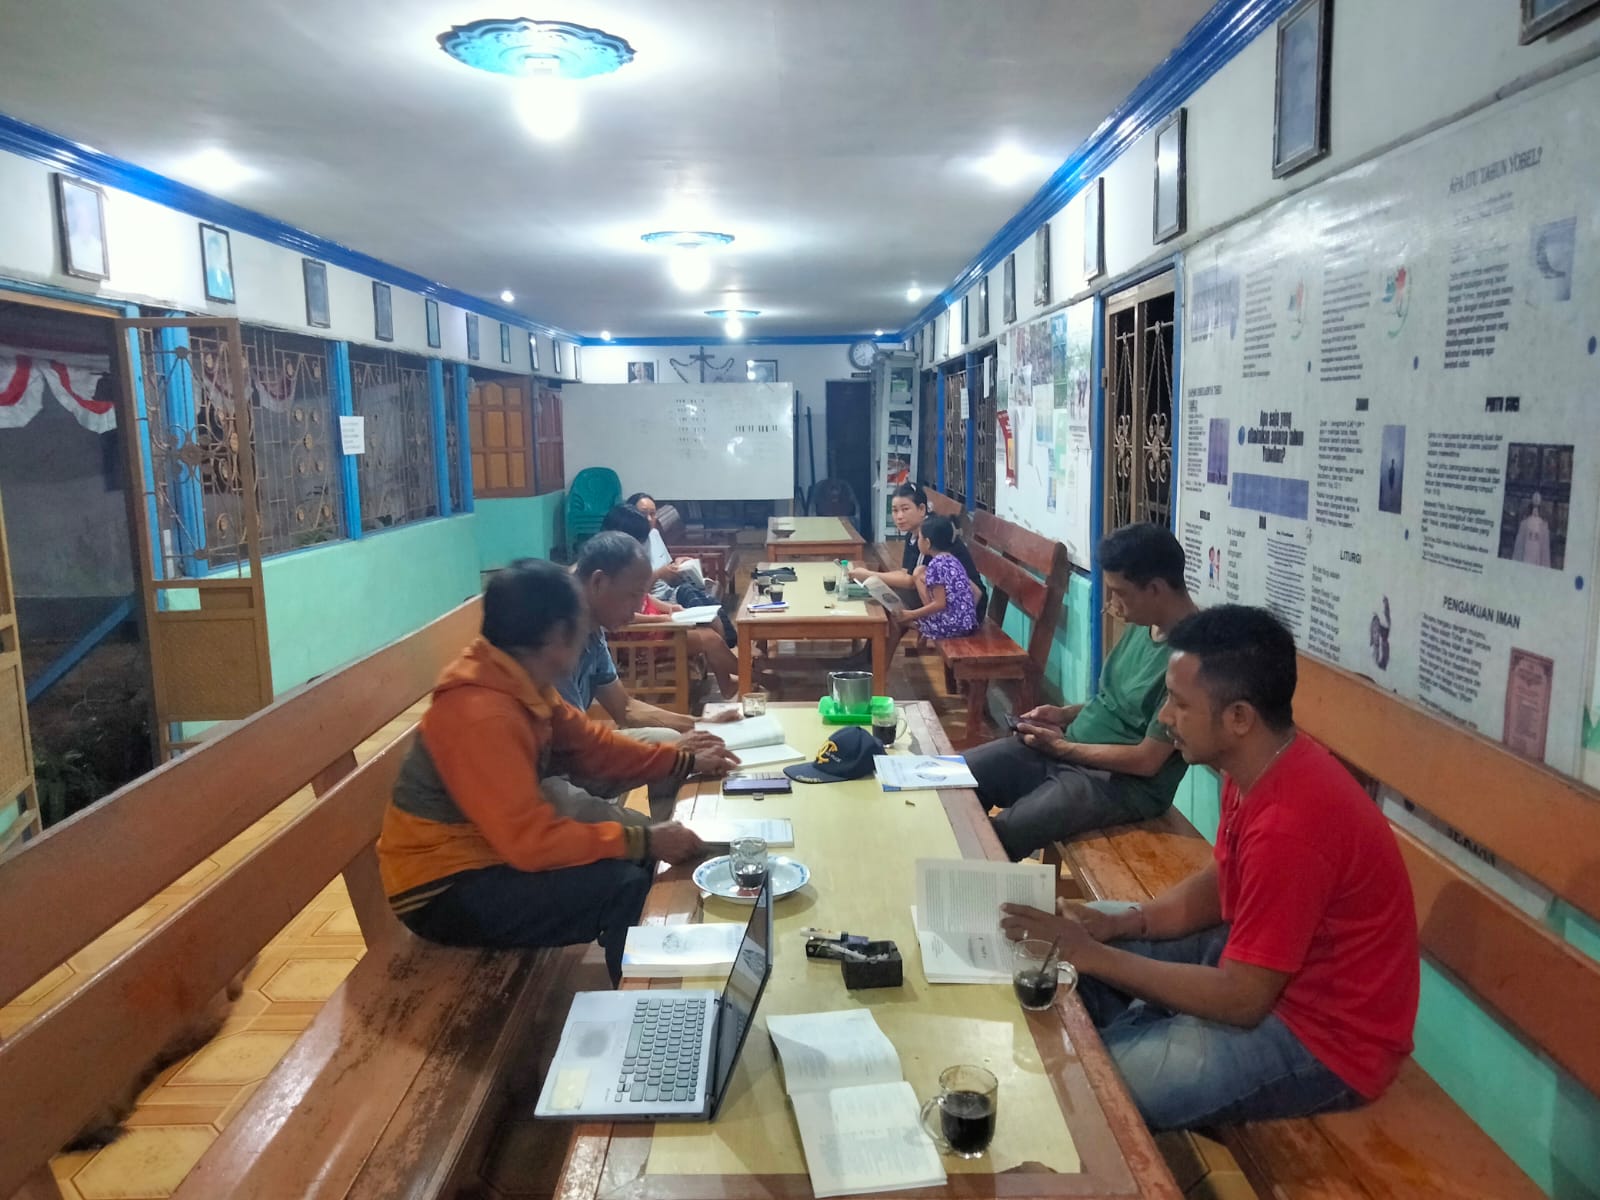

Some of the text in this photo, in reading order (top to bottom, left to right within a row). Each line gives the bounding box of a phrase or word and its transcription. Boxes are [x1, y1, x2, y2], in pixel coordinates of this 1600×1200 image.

[1340, 549, 1362, 565] LITURGI
[1443, 595, 1521, 630] PENGAKUAN IMAN
